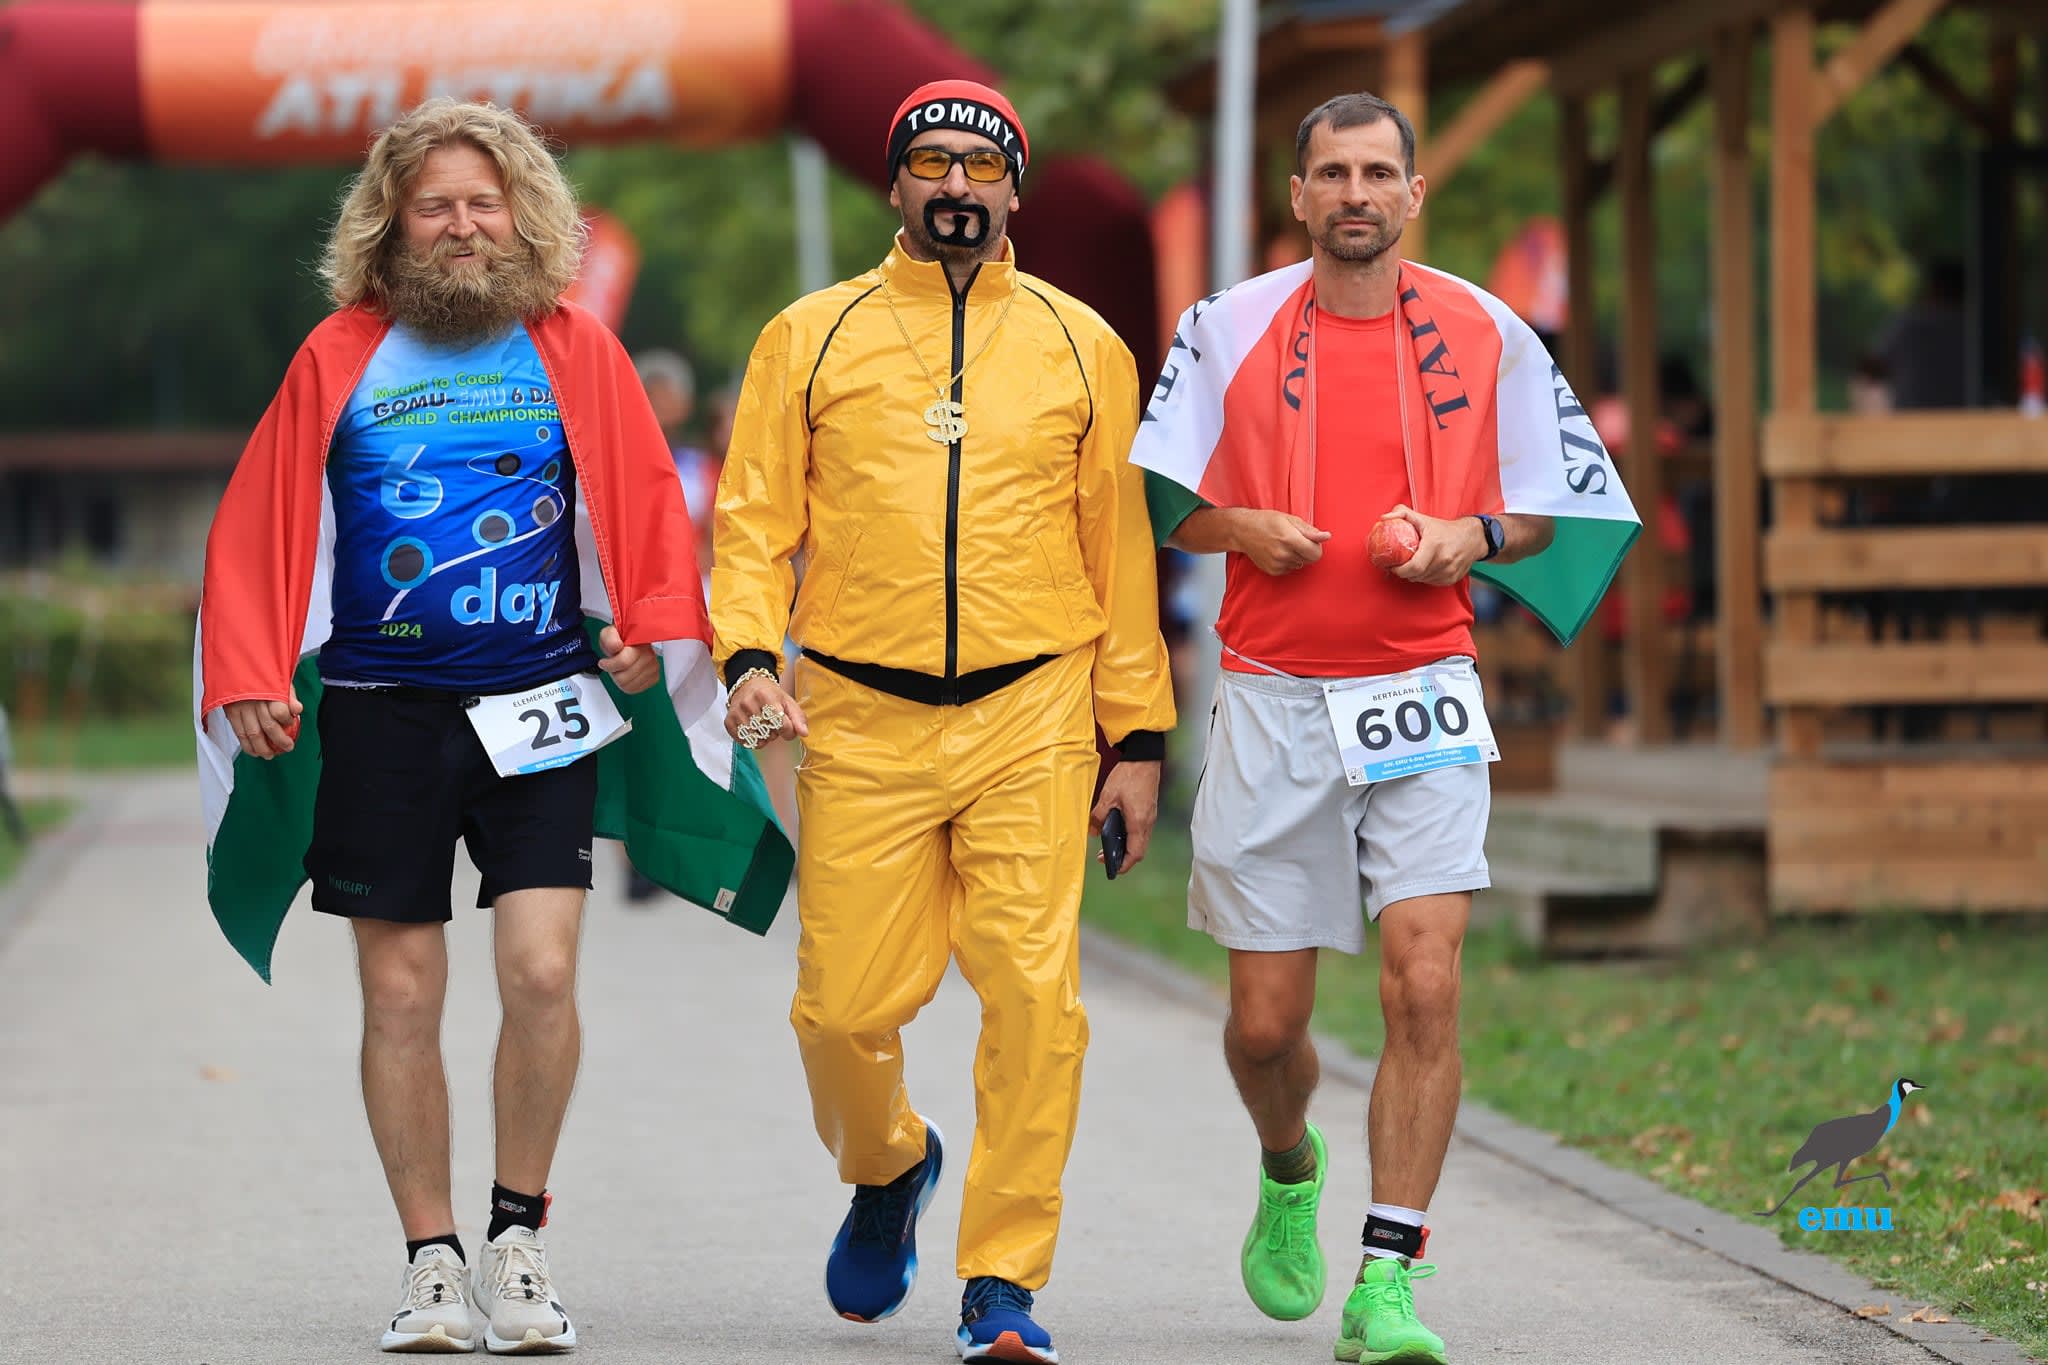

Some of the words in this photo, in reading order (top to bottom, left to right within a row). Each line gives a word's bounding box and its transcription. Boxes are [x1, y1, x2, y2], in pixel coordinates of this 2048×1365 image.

[907, 103, 1015, 148] TOMMY
[373, 381, 428, 399] Mount
[432, 377, 450, 390] to
[455, 371, 504, 387] Coast
[511, 387, 526, 405] 6
[450, 566, 561, 635] day
[378, 622, 423, 639] 2024
[512, 693, 545, 708] ELEMER
[1372, 688, 1415, 701] BERTALAN
[518, 697, 591, 751] 25
[1356, 696, 1470, 751] 600
